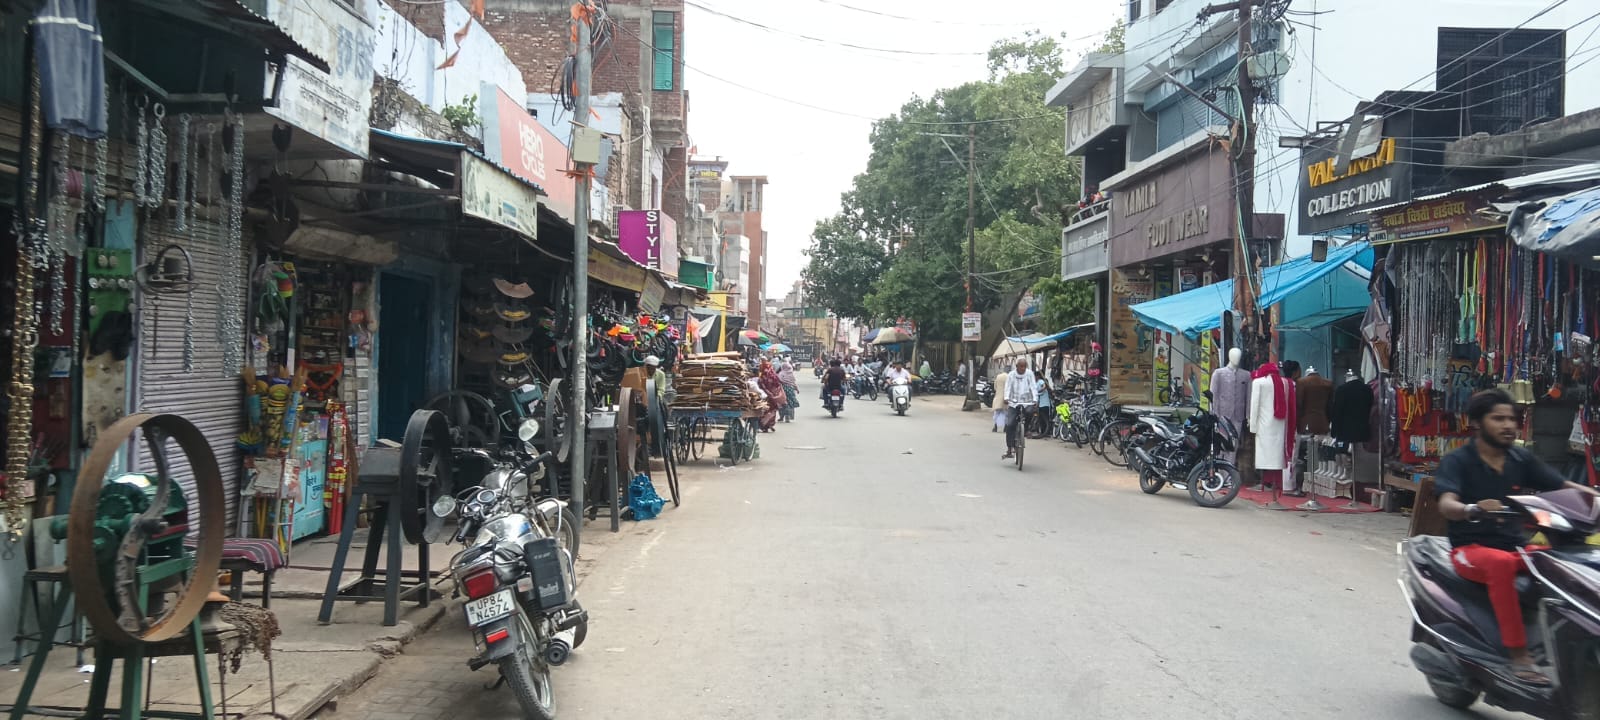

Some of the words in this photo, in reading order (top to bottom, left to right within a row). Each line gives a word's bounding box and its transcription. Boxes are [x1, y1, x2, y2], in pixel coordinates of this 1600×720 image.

[519, 120, 544, 161] HERO
[1124, 182, 1156, 218] KAMLA
[1308, 178, 1392, 217] COLLECTION
[646, 211, 658, 269] STYLE
[1147, 217, 1173, 249] FOOT
[1174, 205, 1208, 241] WEAR
[476, 602, 509, 621] N4574
[477, 594, 503, 610] UP84
